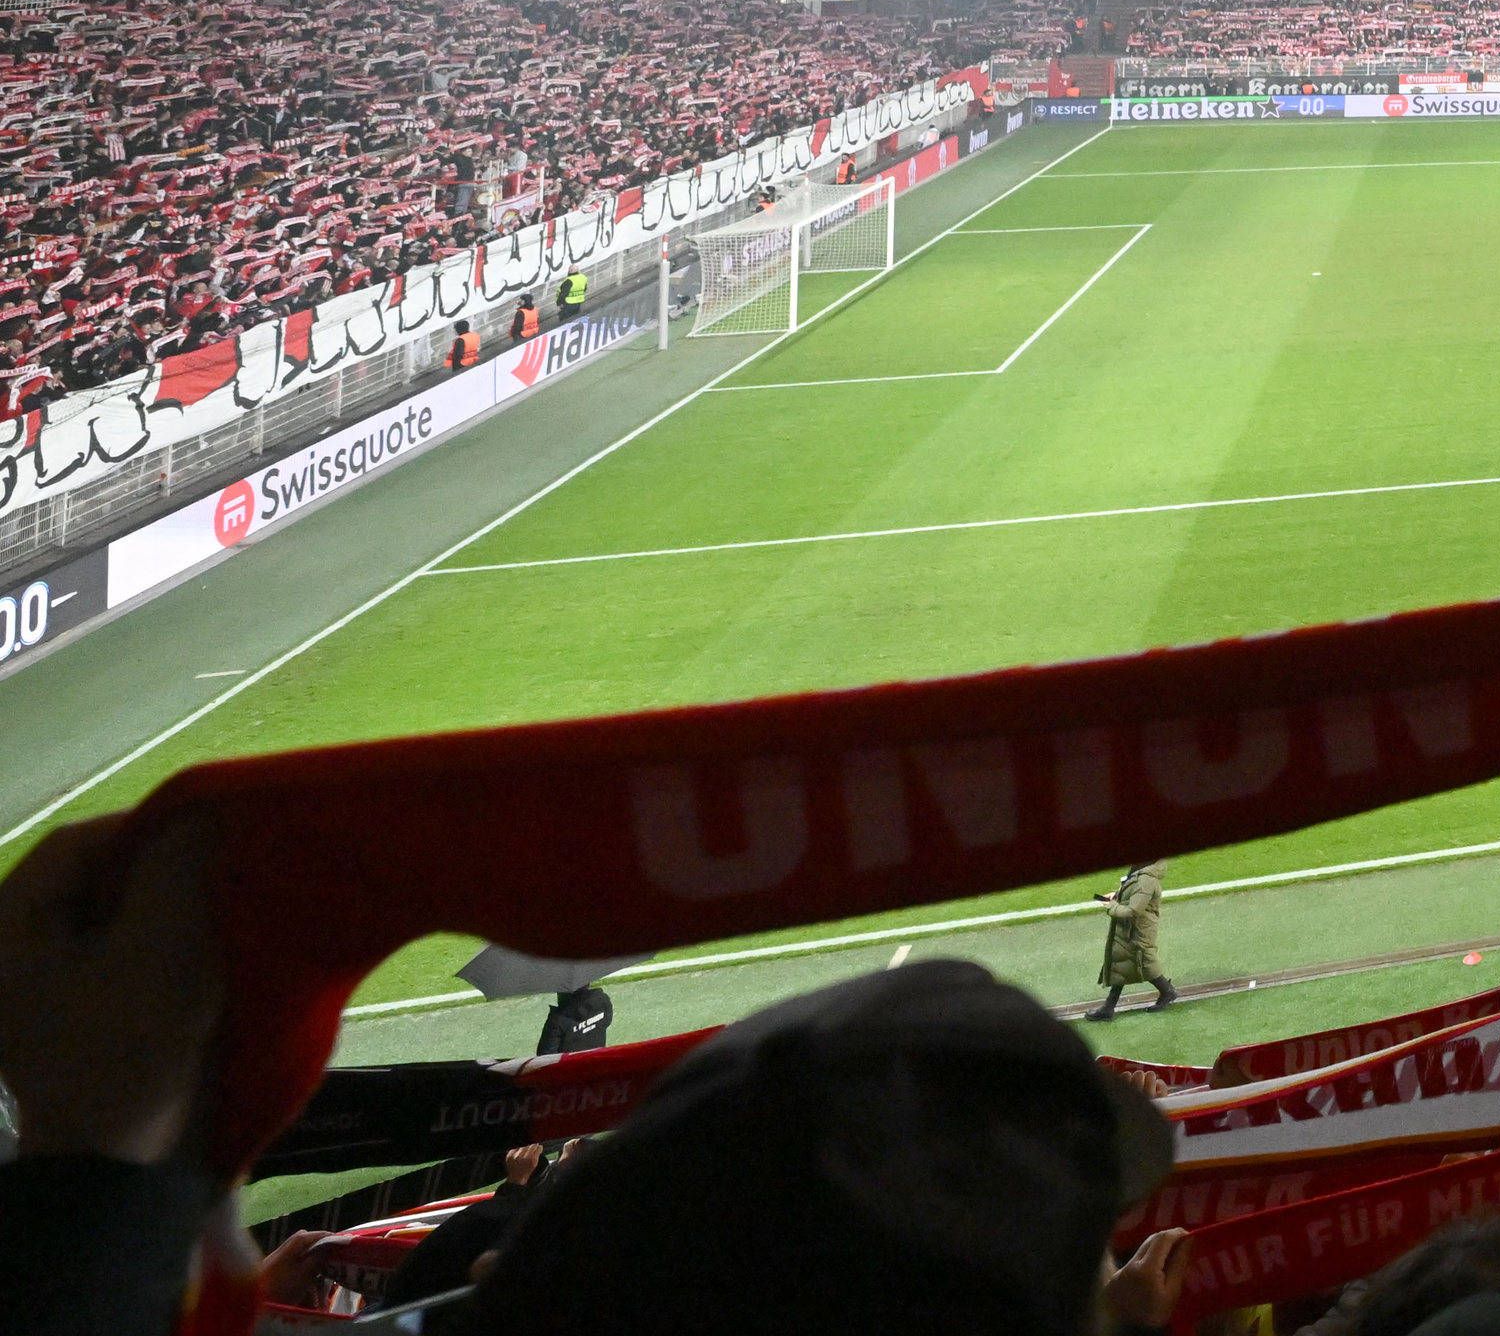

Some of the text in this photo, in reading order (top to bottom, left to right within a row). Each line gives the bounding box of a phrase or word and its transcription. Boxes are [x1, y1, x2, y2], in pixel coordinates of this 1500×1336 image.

[1051, 105, 1098, 115] RESPECT
[1110, 98, 1255, 121] Heineken
[261, 402, 434, 521] Swissquote
[1303, 1195, 1405, 1262] FÜR
